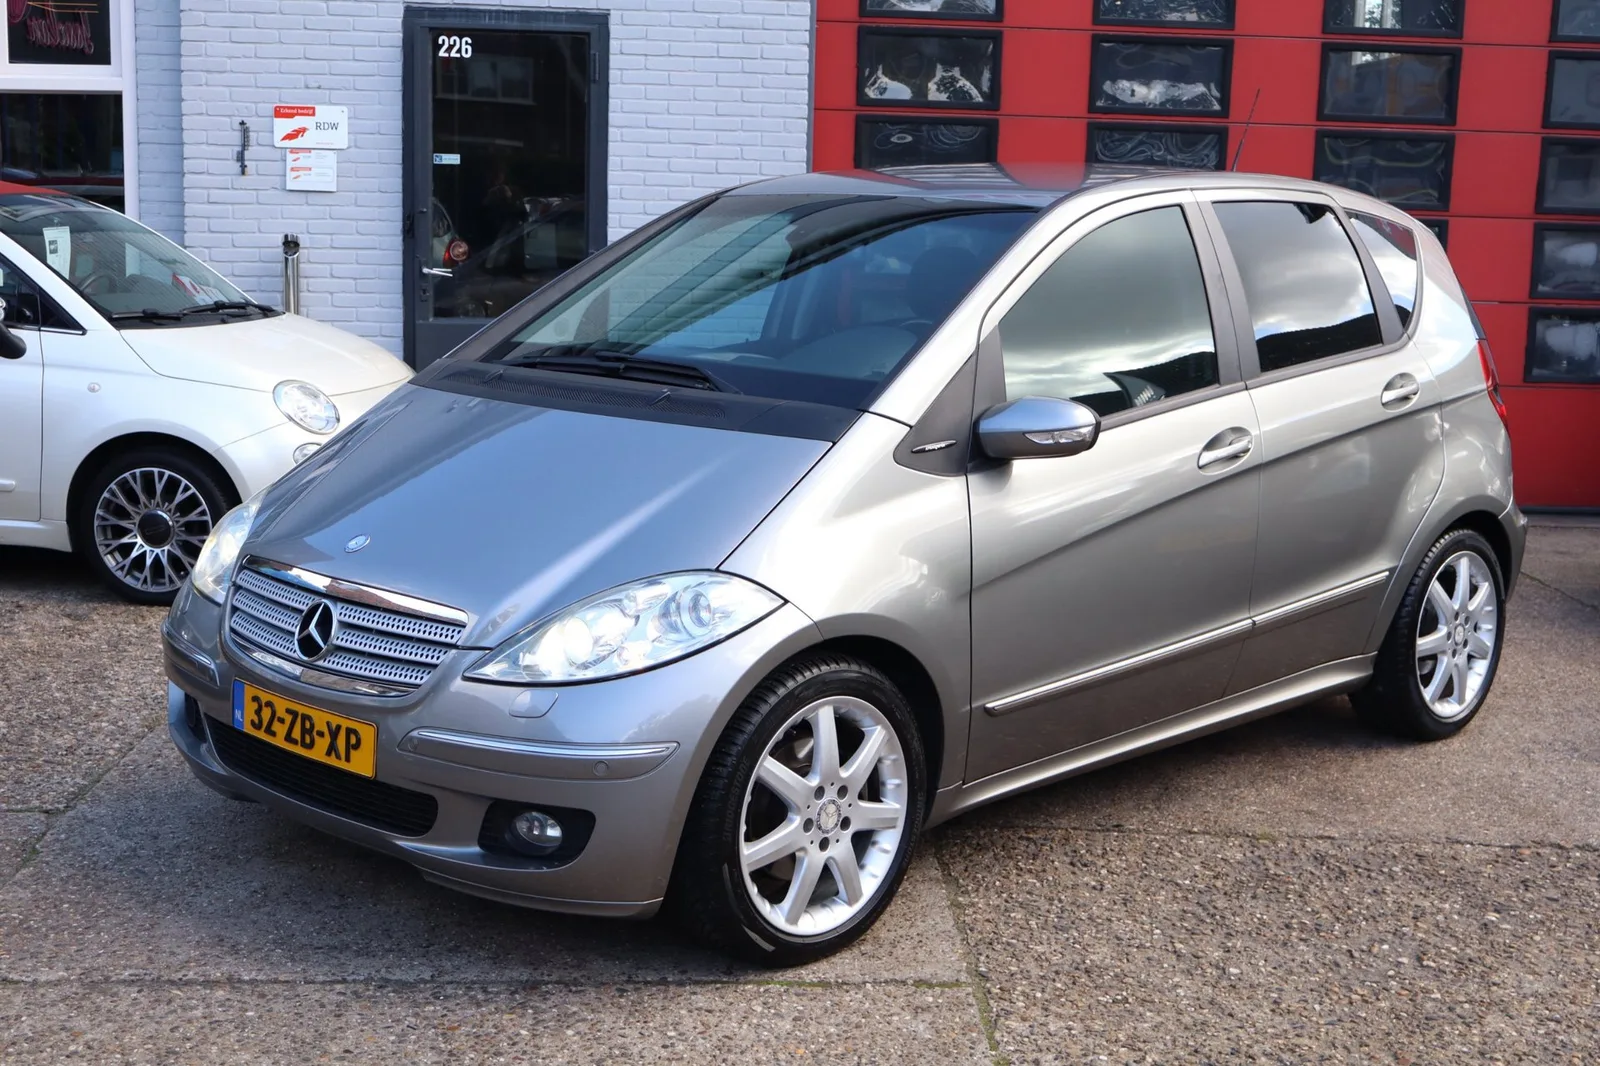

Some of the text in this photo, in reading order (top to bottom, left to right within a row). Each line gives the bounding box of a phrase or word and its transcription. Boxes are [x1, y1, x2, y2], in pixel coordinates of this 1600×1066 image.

[438, 35, 472, 58] 226
[315, 121, 339, 131] RDW
[235, 708, 243, 722] NL
[250, 695, 362, 763] 32-ZB-XP
